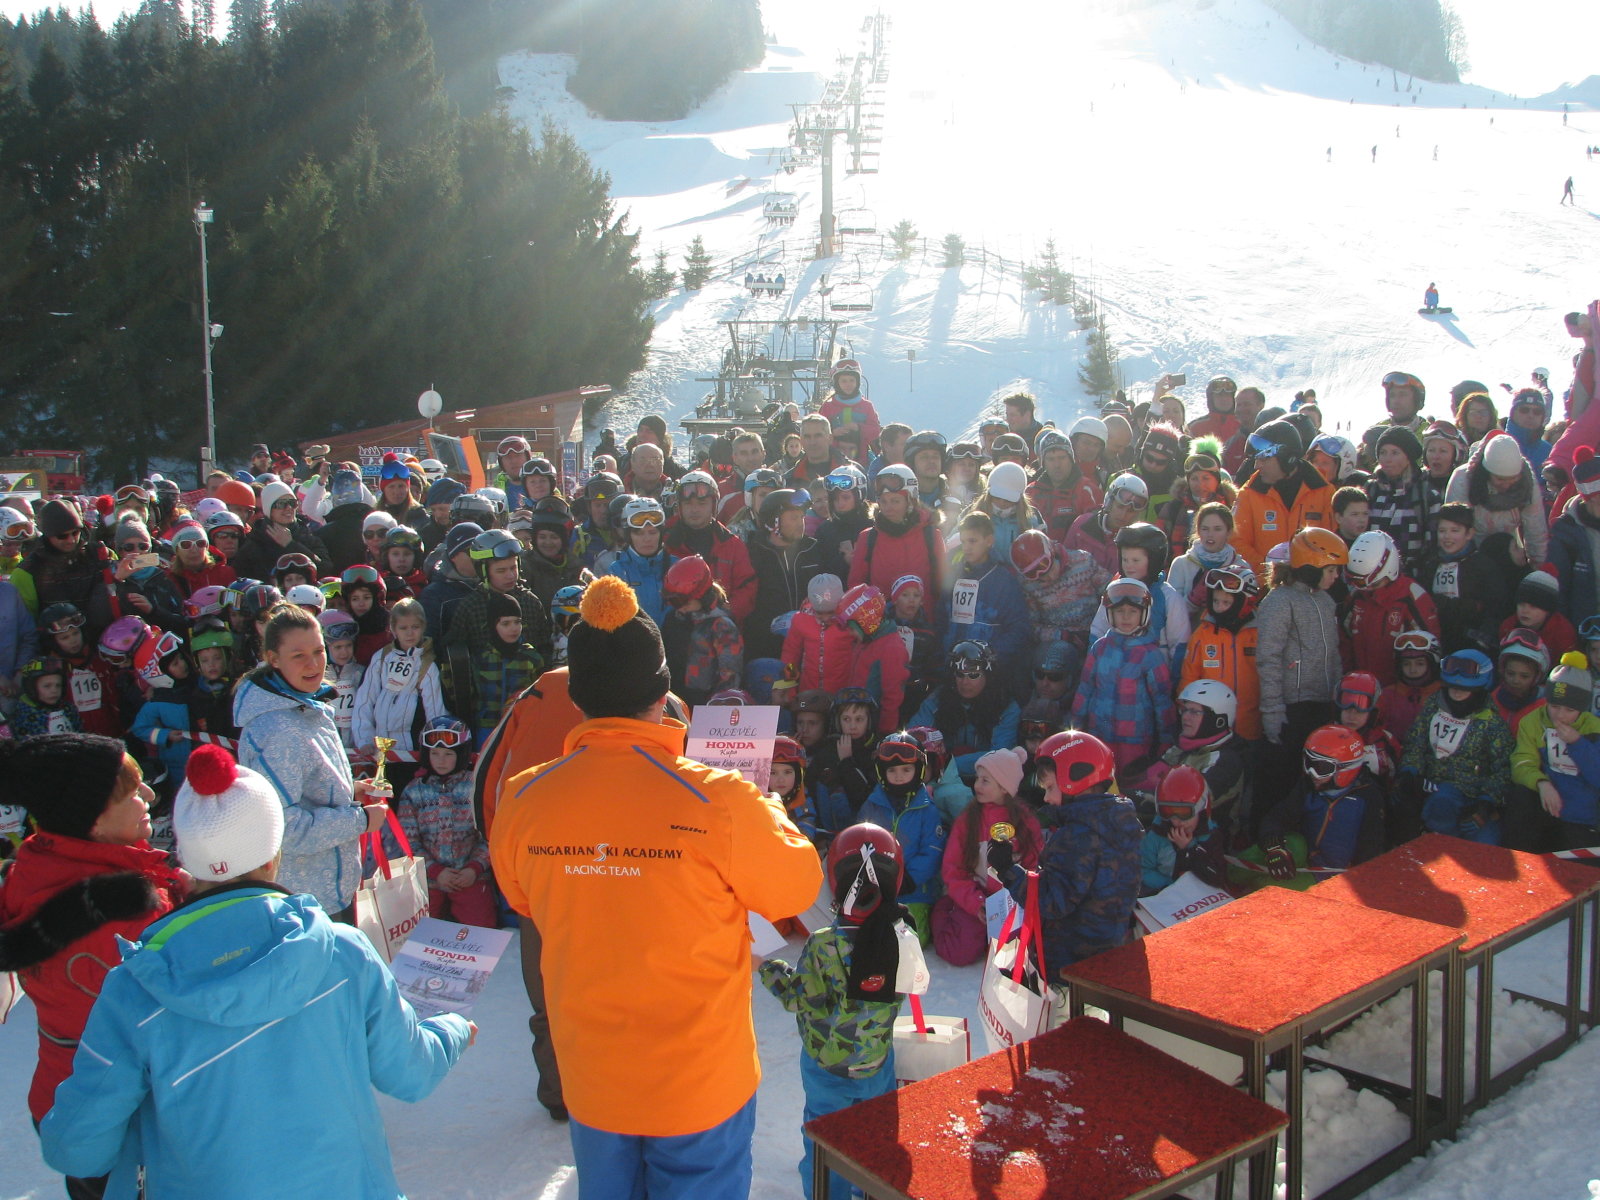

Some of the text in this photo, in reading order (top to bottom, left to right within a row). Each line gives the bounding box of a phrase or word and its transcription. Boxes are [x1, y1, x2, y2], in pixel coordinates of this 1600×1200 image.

[1436, 571, 1455, 586] 155
[955, 591, 975, 606] 187
[388, 661, 412, 677] 166
[75, 679, 99, 695] 116
[709, 726, 758, 737] OKLEVÉL
[1433, 722, 1458, 744] 151
[705, 741, 756, 749] HONDA
[1052, 738, 1084, 757] CARRERA
[527, 843, 683, 862] HUNGARIAN SKI ACADEMY
[565, 865, 641, 876] RACING TEAM
[1171, 892, 1230, 920] HONDA
[388, 903, 430, 941] HONDA
[423, 947, 477, 962] HONDA
[979, 992, 1014, 1046] HONDA
